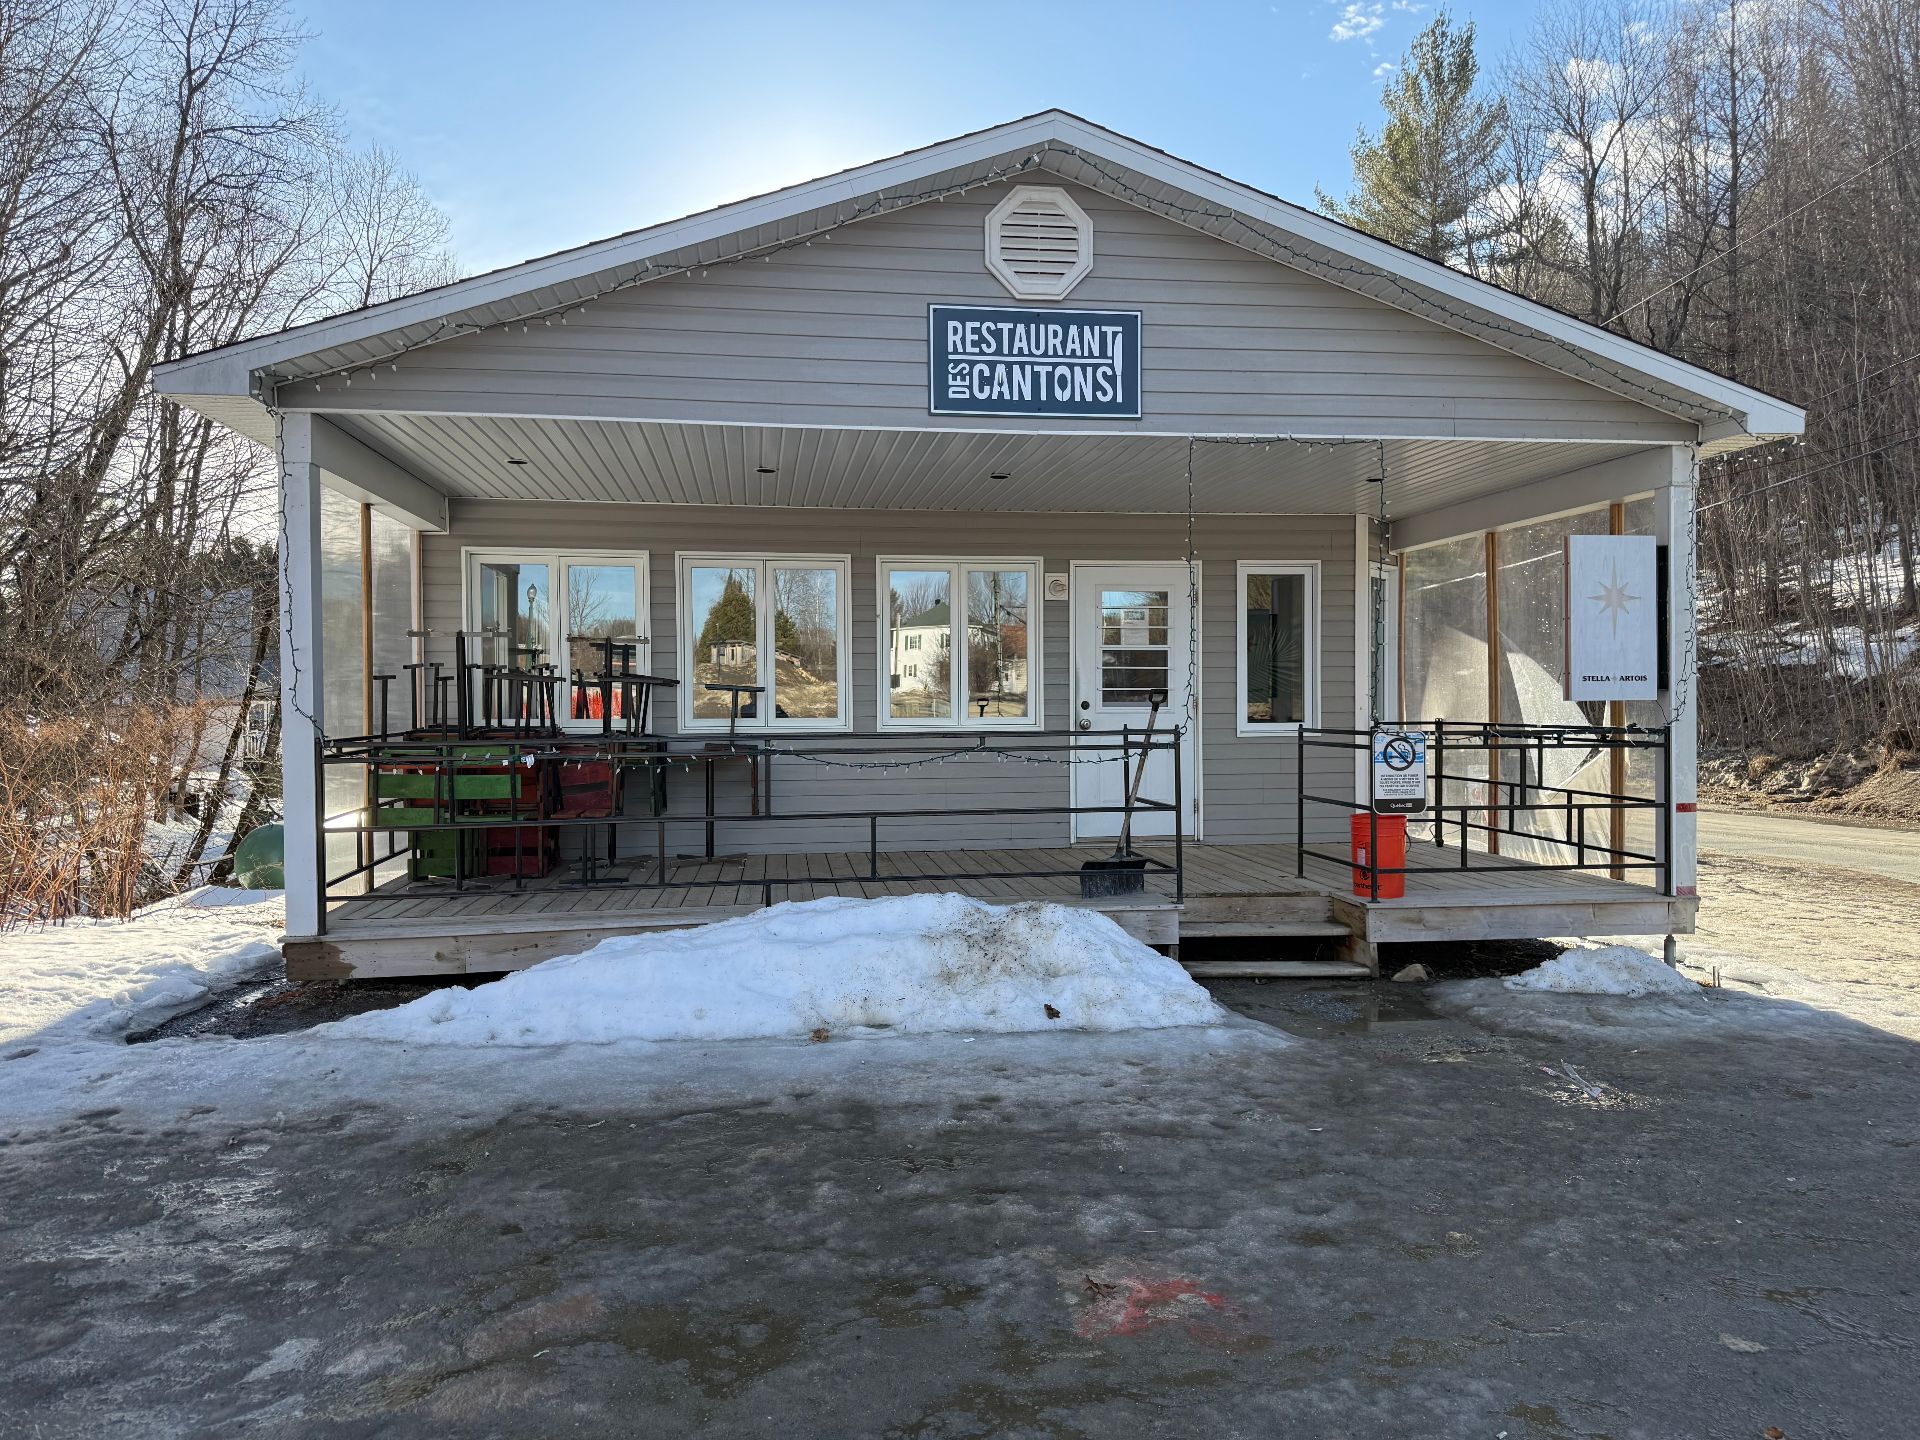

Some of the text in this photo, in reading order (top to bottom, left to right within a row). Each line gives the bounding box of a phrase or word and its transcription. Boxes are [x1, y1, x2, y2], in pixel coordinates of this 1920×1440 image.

[947, 320, 1123, 357] RESTAURANT
[948, 362, 970, 399] DES
[972, 363, 1114, 402] CANTONS
